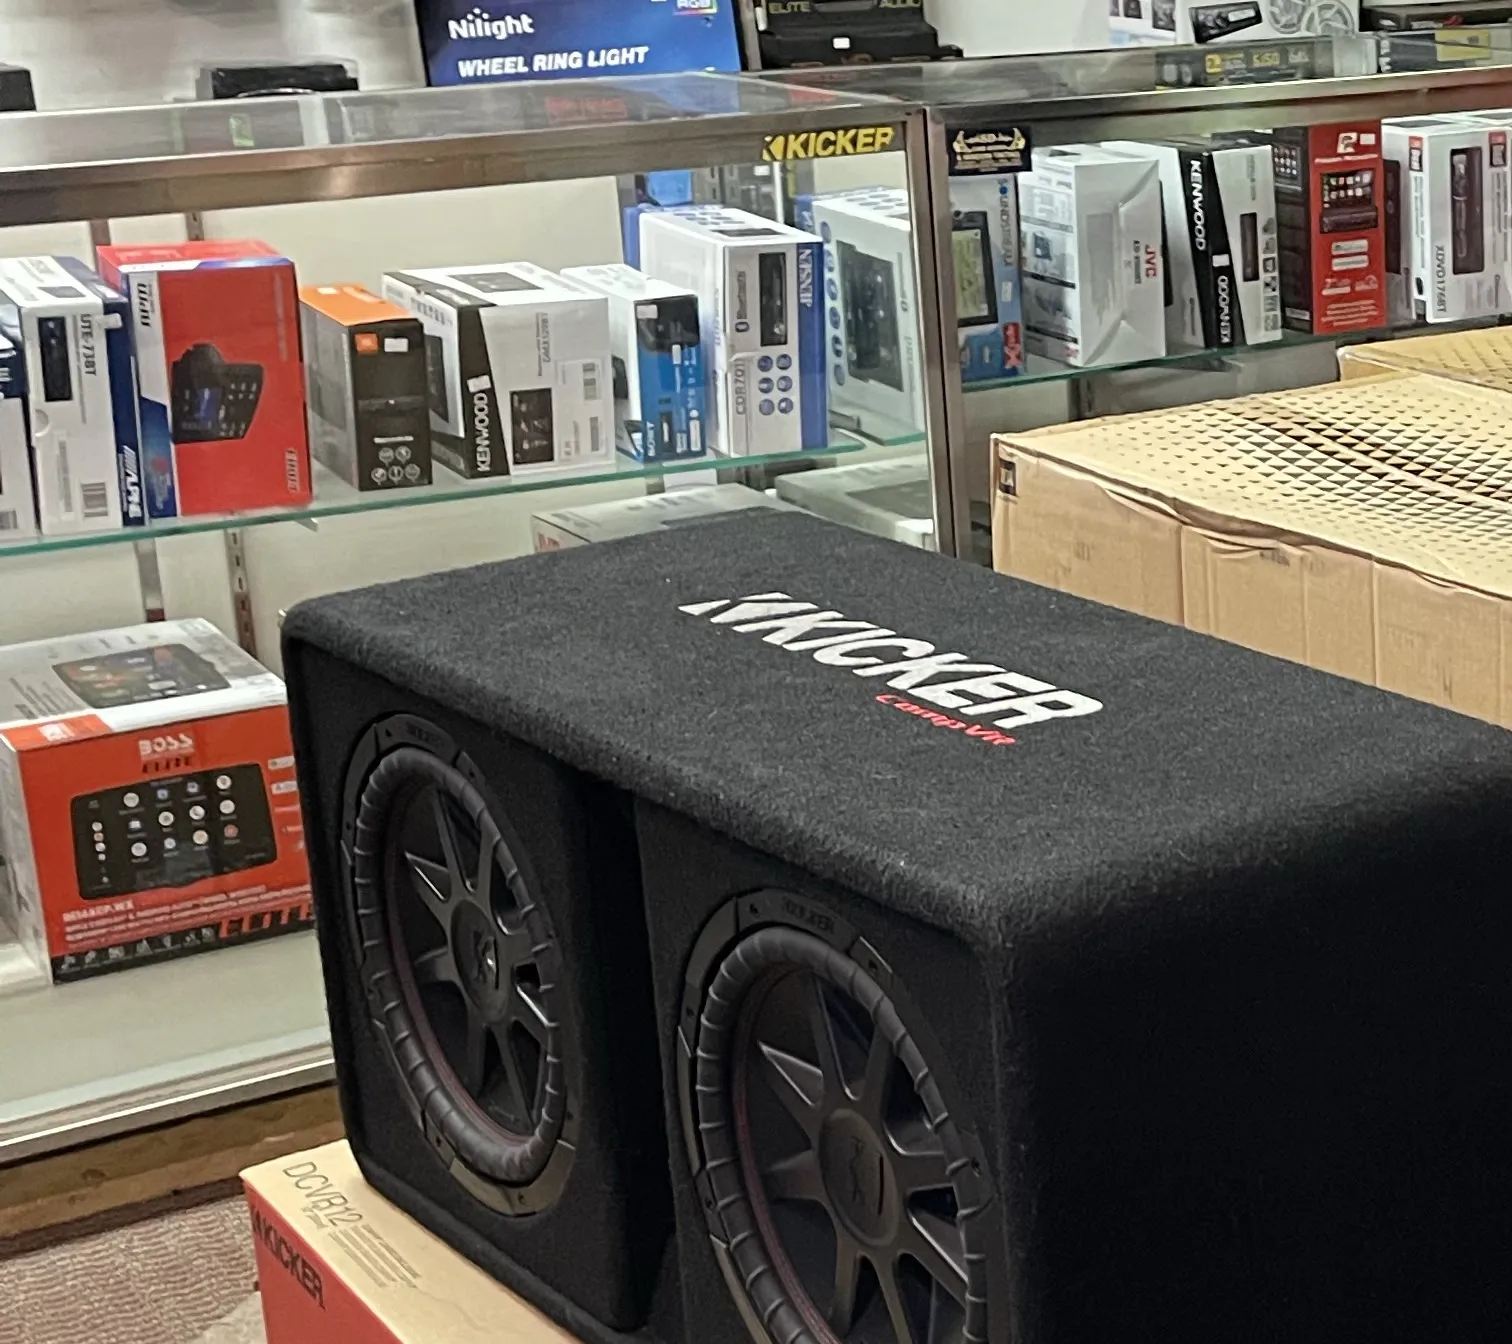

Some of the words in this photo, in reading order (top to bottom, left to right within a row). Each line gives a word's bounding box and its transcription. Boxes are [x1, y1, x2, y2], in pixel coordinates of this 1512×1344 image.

[448, 8, 534, 40] Nilight
[458, 56, 529, 78] WHEEL
[533, 51, 583, 72] RING
[588, 46, 650, 68] LIGHT
[783, 127, 896, 159] KICKER
[1190, 159, 1206, 250] KENWOOD
[1144, 244, 1158, 278] JVC
[1217, 276, 1231, 343] KENWOOD
[474, 392, 491, 472] KENWOOD
[728, 606, 1103, 729] KICKER
[256, 1214, 326, 1313] KICKER
